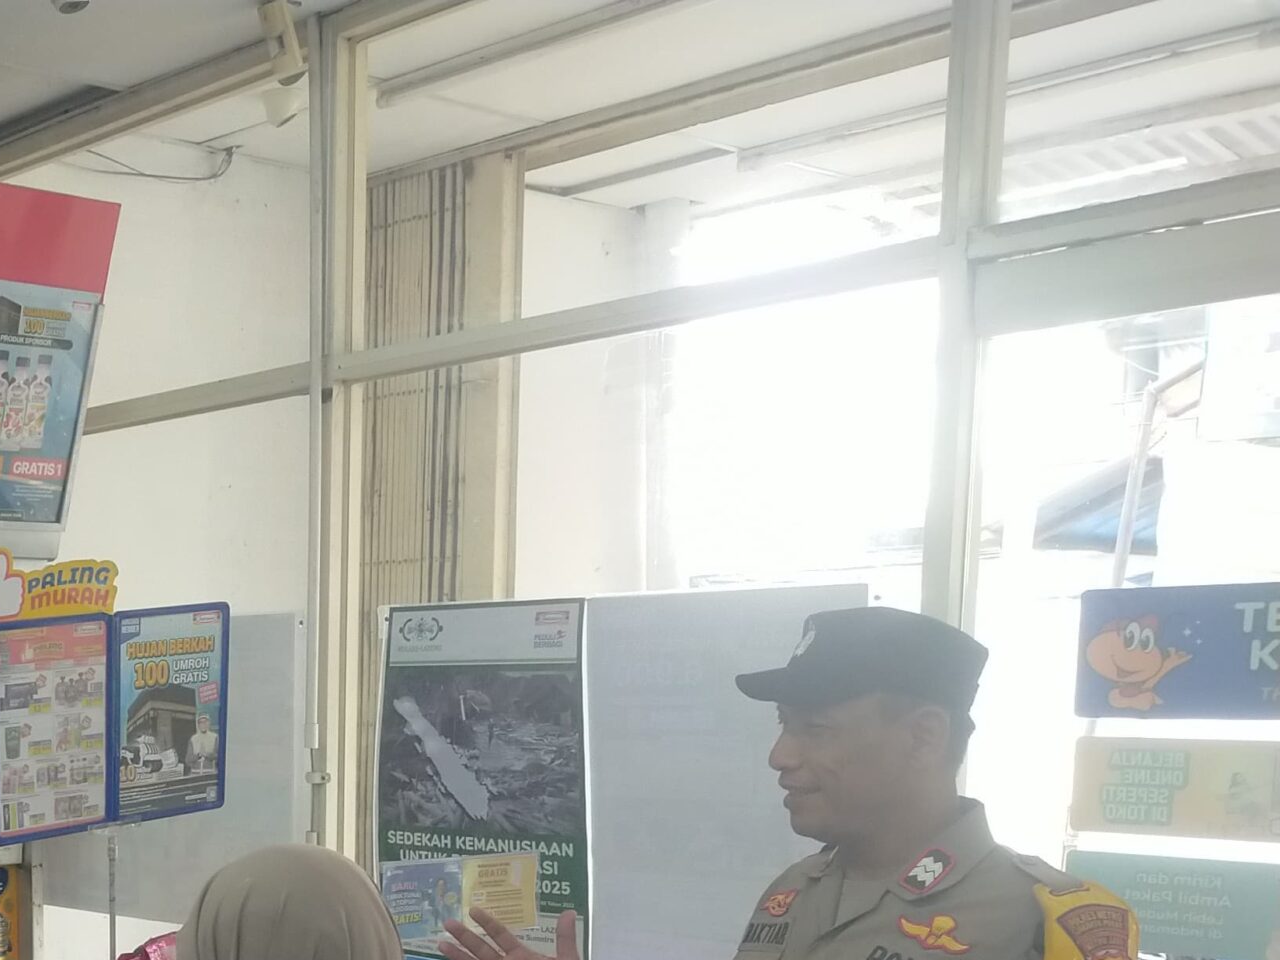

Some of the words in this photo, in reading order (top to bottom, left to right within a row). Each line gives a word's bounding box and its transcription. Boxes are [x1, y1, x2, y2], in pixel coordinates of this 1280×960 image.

[23, 318, 46, 336] 100
[0, 333, 24, 344] PRODUK
[13, 460, 55, 476] GRATIS
[56, 463, 63, 477] 1
[27, 565, 110, 594] PALING
[30, 586, 110, 611] MURAH
[127, 639, 167, 660] HUJAN
[169, 635, 215, 656] BERKAH
[133, 660, 170, 689] 100
[173, 657, 209, 671] UMROH
[172, 669, 209, 684] GRATIS
[387, 830, 451, 849] SEDEKAH
[456, 835, 573, 858] KEMANUSIAAN
